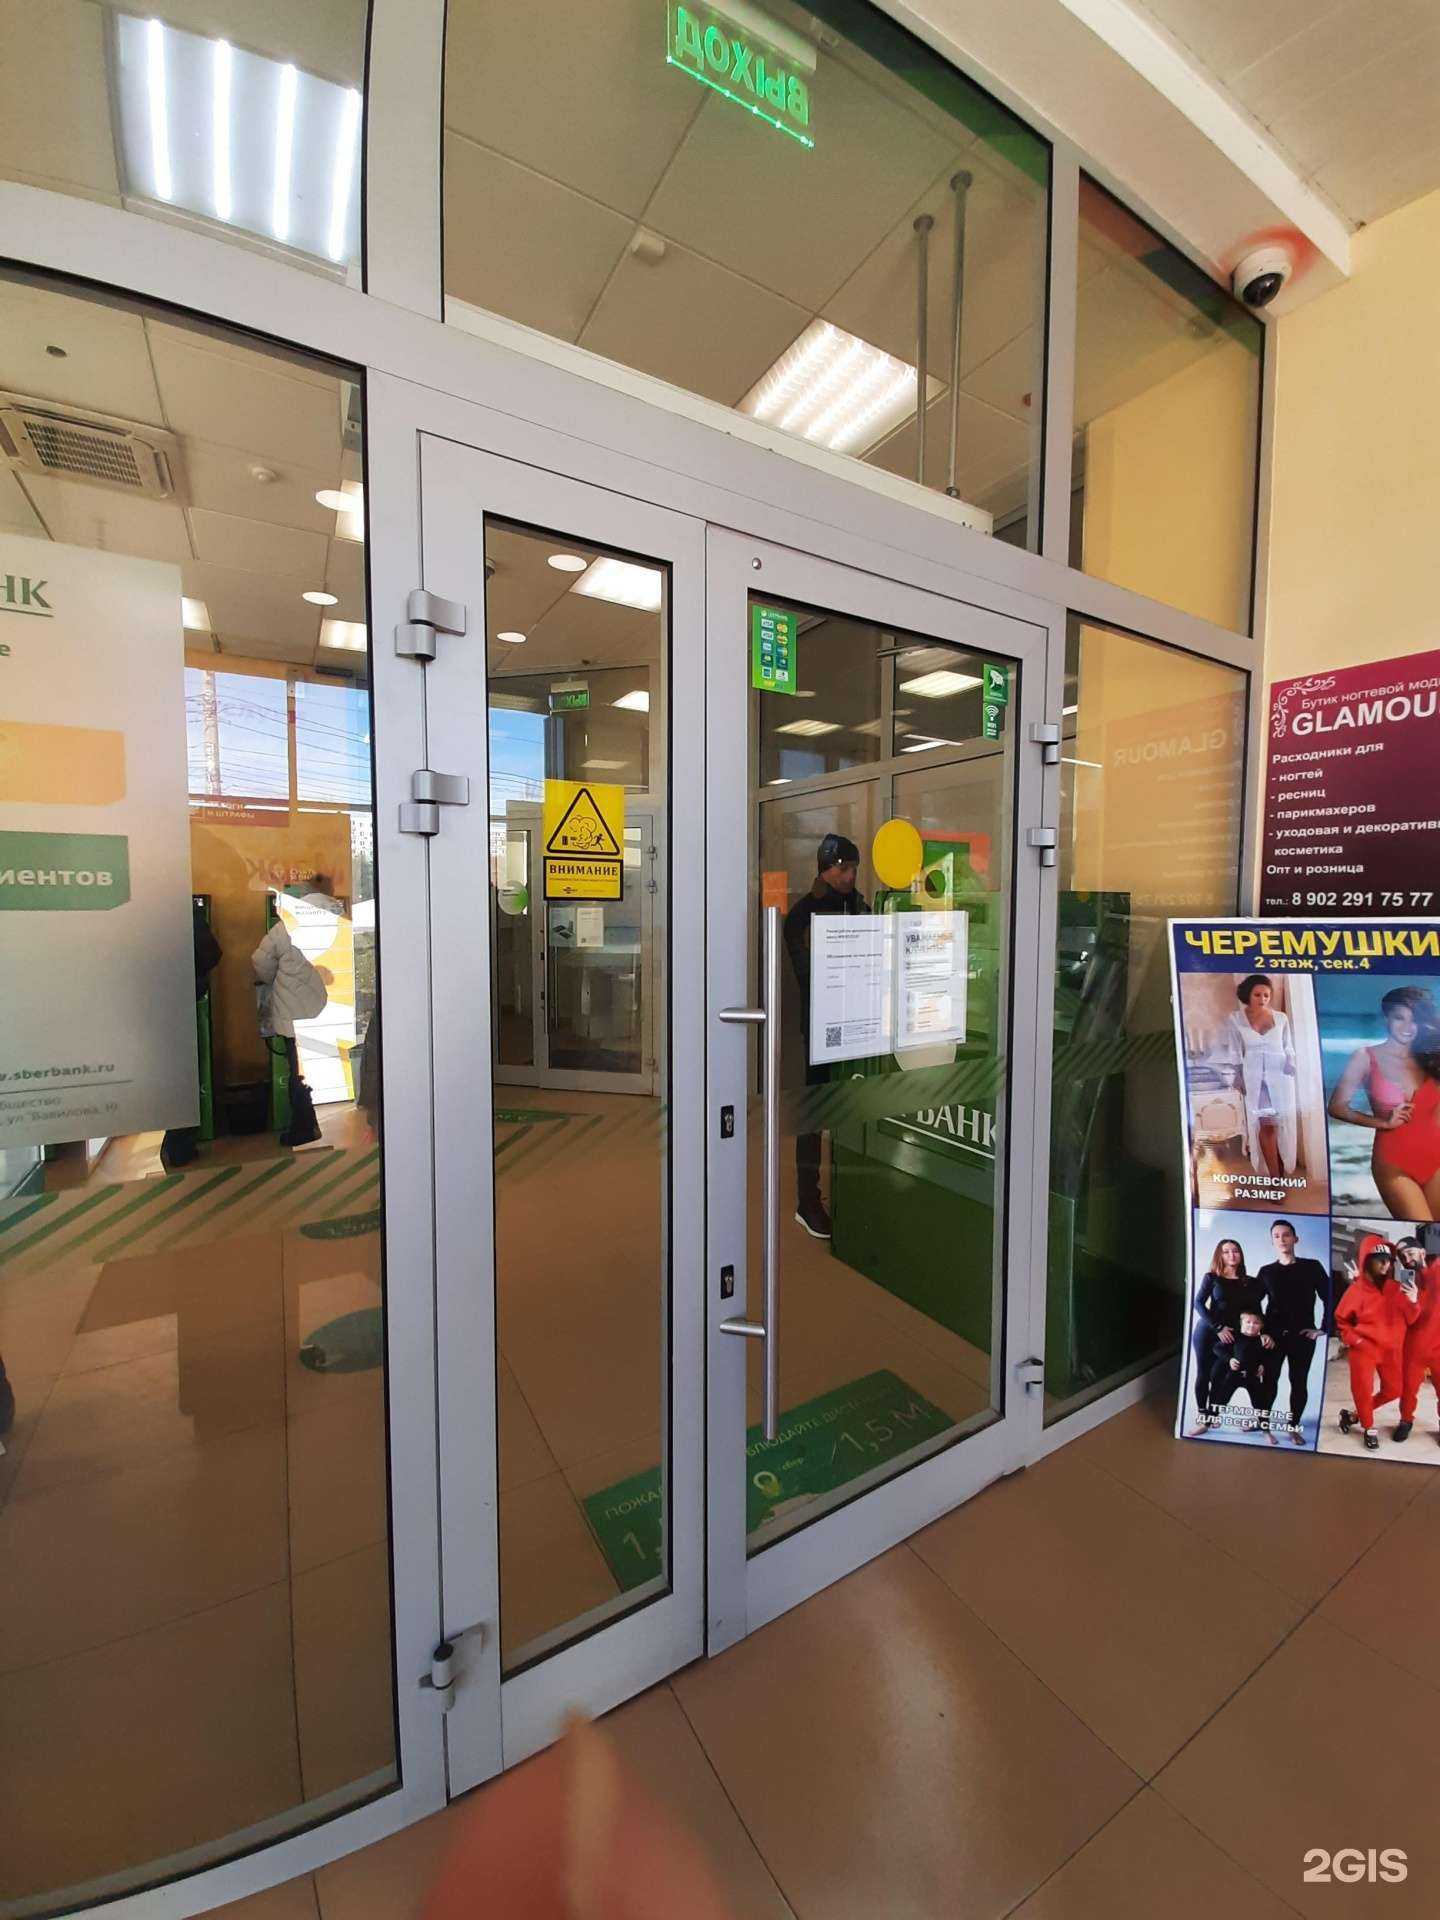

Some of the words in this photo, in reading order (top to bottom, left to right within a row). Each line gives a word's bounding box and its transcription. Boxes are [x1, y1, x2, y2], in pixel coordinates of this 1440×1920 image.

[1301, 694, 1338, 709] Бутик
[1341, 681, 1404, 702] ногтевой
[1408, 677, 1440, 692] мод
[1291, 690, 1440, 736] GLAMOU
[1272, 747, 1352, 764] Расходники
[1355, 742, 1384, 755] для
[1279, 768, 1323, 782] ногтей
[1278, 788, 1326, 802] ресниц
[1277, 803, 1376, 820] парикмахеров
[1276, 826, 1339, 840] уходовая
[1343, 825, 1352, 834] и
[1355, 819, 1440, 834] декоратив
[1274, 844, 1343, 856] косметика
[549, 864, 618, 876] ВНИМАНИЕ
[1266, 865, 1291, 875] Опт
[1294, 866, 1302, 874] и
[1306, 864, 1364, 876] розница
[1291, 892, 1301, 906] 8
[1306, 892, 1337, 906] 902
[1342, 892, 1373, 906] 291
[1380, 892, 1404, 907] 75
[1409, 892, 1433, 907] 77
[1184, 930, 1440, 958] ЧЕРЕМУШКИ
[1254, 957, 1265, 968] 2
[1269, 958, 1319, 970] этаж,
[1212, 1174, 1307, 1189] КОРОЛЕВСКИЙ
[1234, 1188, 1286, 1201] РАЗМЕР
